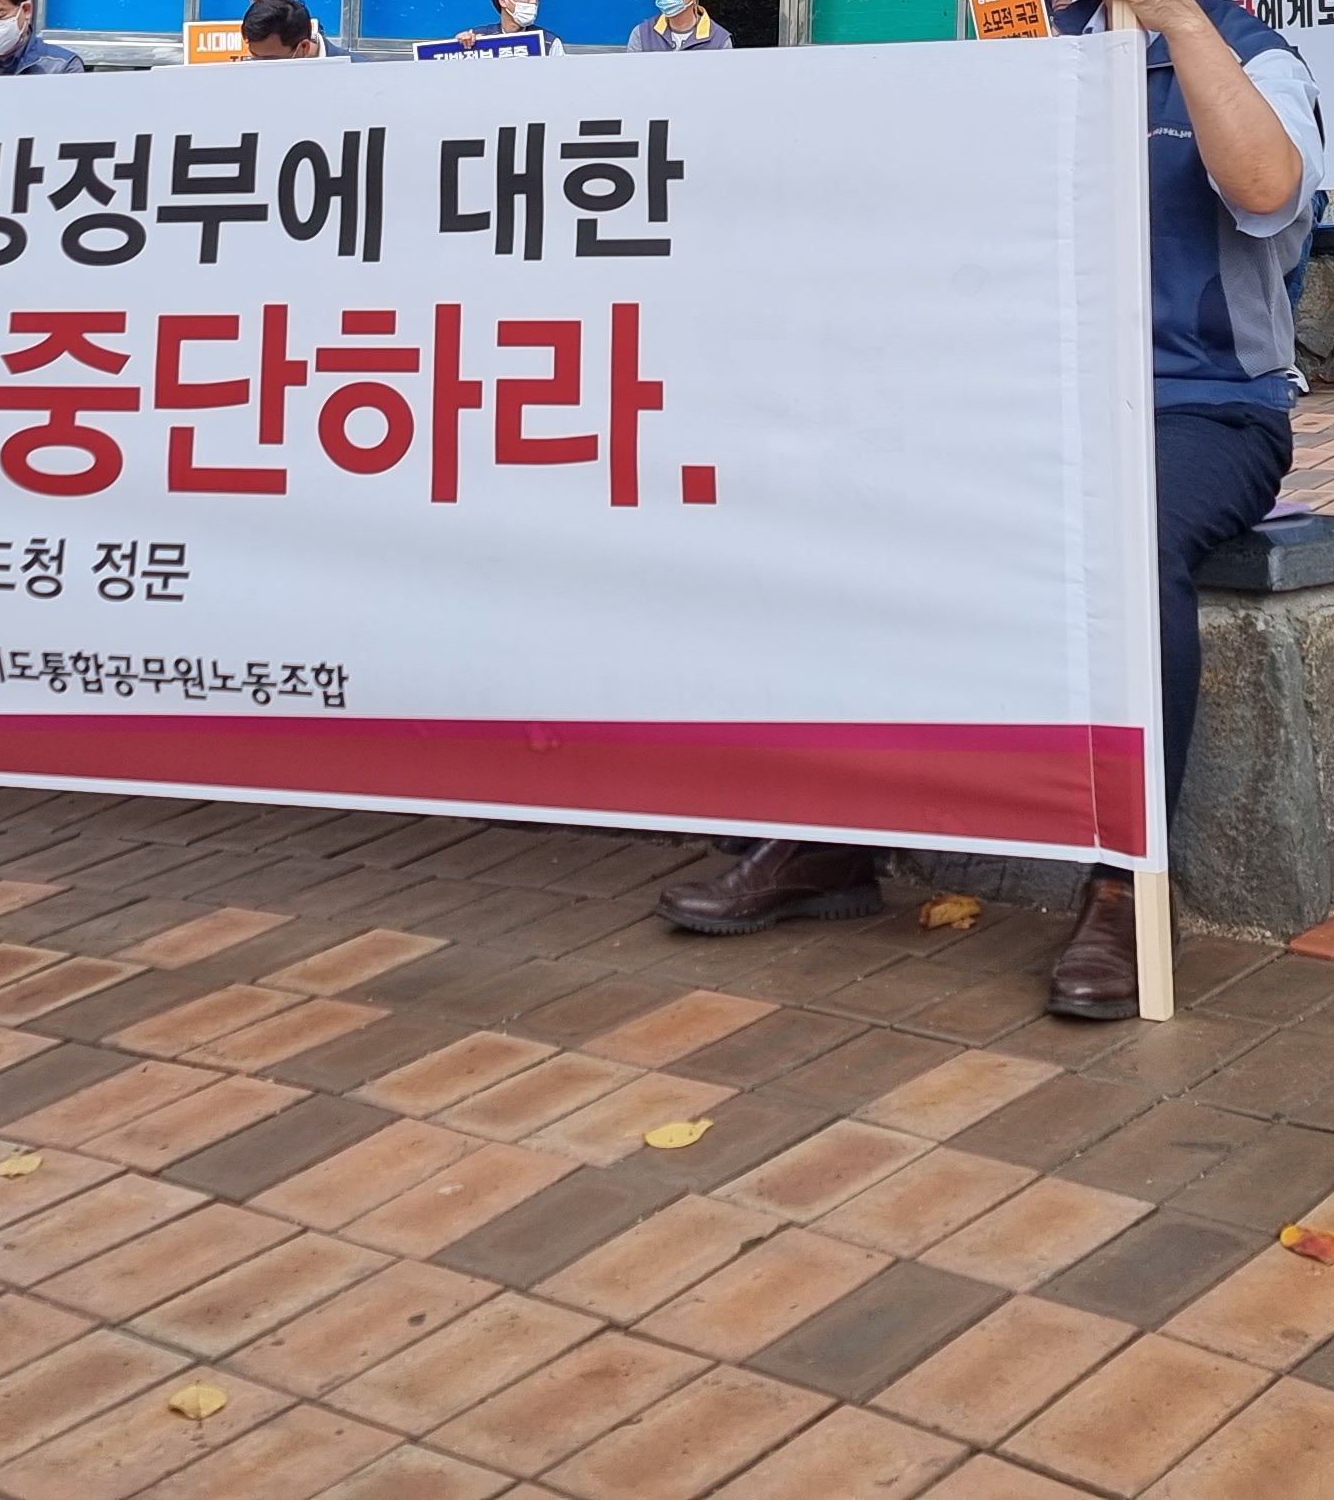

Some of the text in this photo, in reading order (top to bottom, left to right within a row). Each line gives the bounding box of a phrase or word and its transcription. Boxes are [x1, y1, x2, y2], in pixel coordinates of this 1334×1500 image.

[983, 1, 1040, 34] 소모적 국감
[439, 119, 684, 261] 대한
[90, 539, 190, 602] 정문
